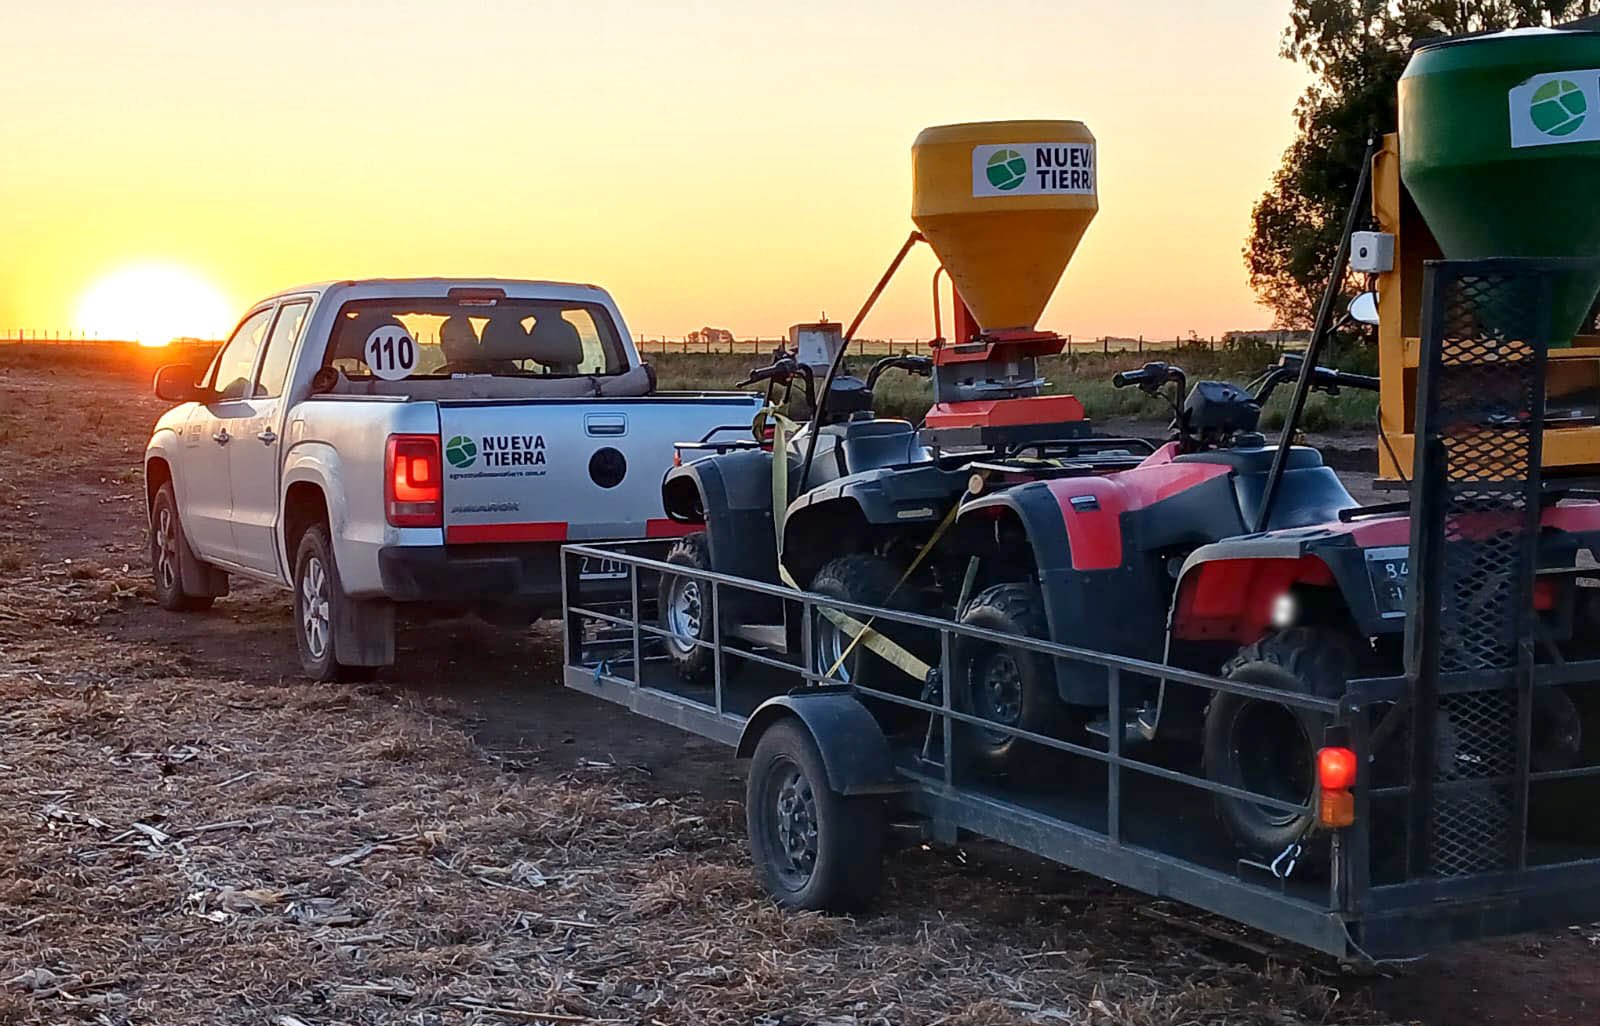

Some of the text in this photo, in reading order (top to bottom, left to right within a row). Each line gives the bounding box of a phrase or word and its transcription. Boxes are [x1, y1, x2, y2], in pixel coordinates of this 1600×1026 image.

[370, 336, 414, 371] 110
[482, 435, 546, 451] NUEVA
[483, 450, 546, 467] TIERRA
